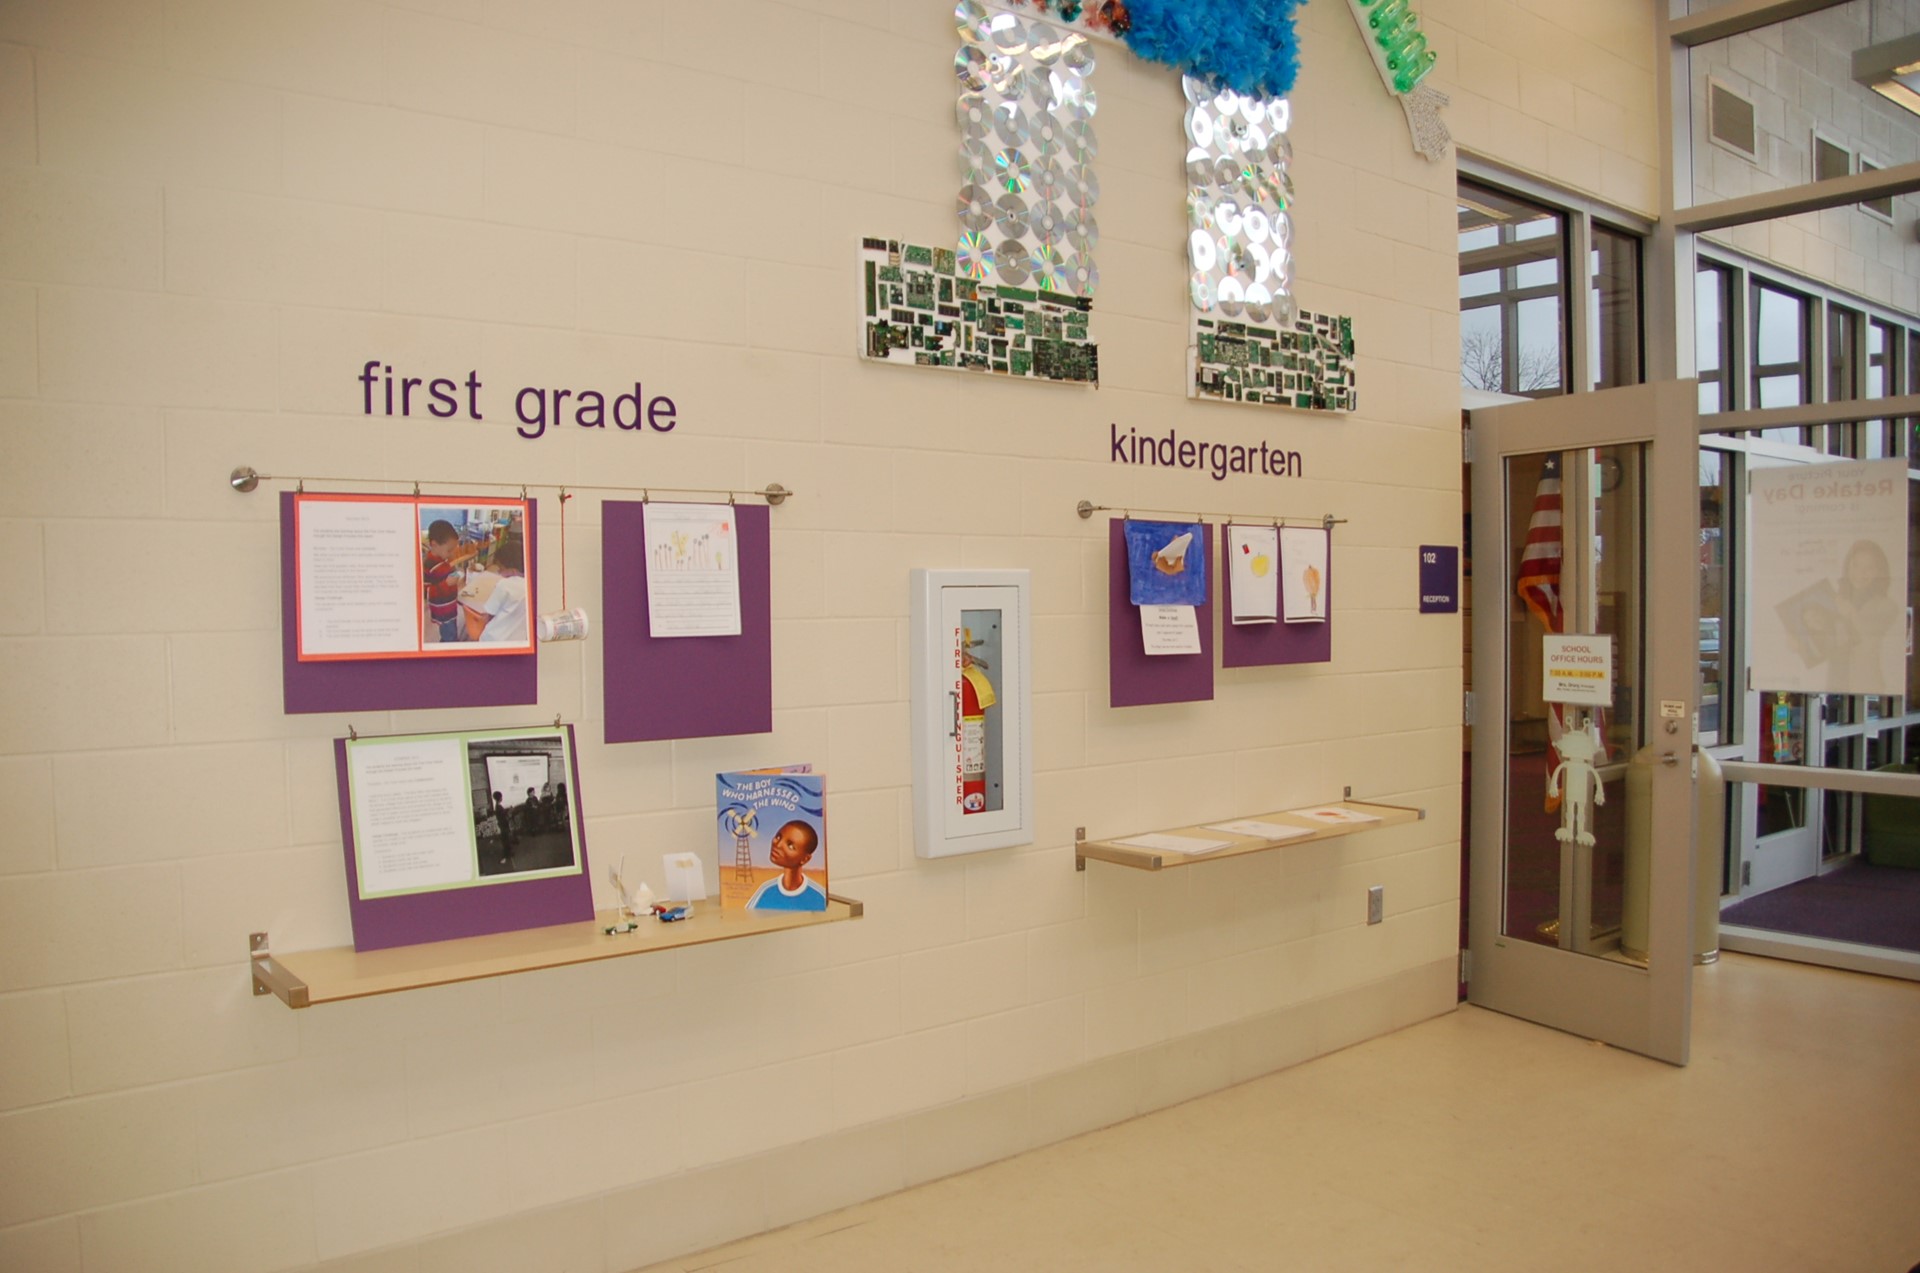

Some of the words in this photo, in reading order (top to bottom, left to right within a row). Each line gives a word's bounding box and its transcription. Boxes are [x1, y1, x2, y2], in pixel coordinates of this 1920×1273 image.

[358, 360, 483, 420] first
[514, 382, 677, 439] grade
[1110, 423, 1302, 481] kindergarten
[1422, 552, 1436, 564] 102
[1422, 595, 1450, 603] RECEPTION
[1561, 645, 1591, 654] SCHOOL
[1550, 654, 1576, 663] OFFICE
[1577, 656, 1604, 664] HOURS
[954, 680, 963, 805] EXTINGUISHER
[736, 782, 753, 791] THE
[755, 778, 771, 790] BOY
[722, 788, 745, 801] WHO
[745, 787, 800, 804] HARNESSED
[752, 798, 769, 810] THE
[770, 798, 796, 812] WIND
